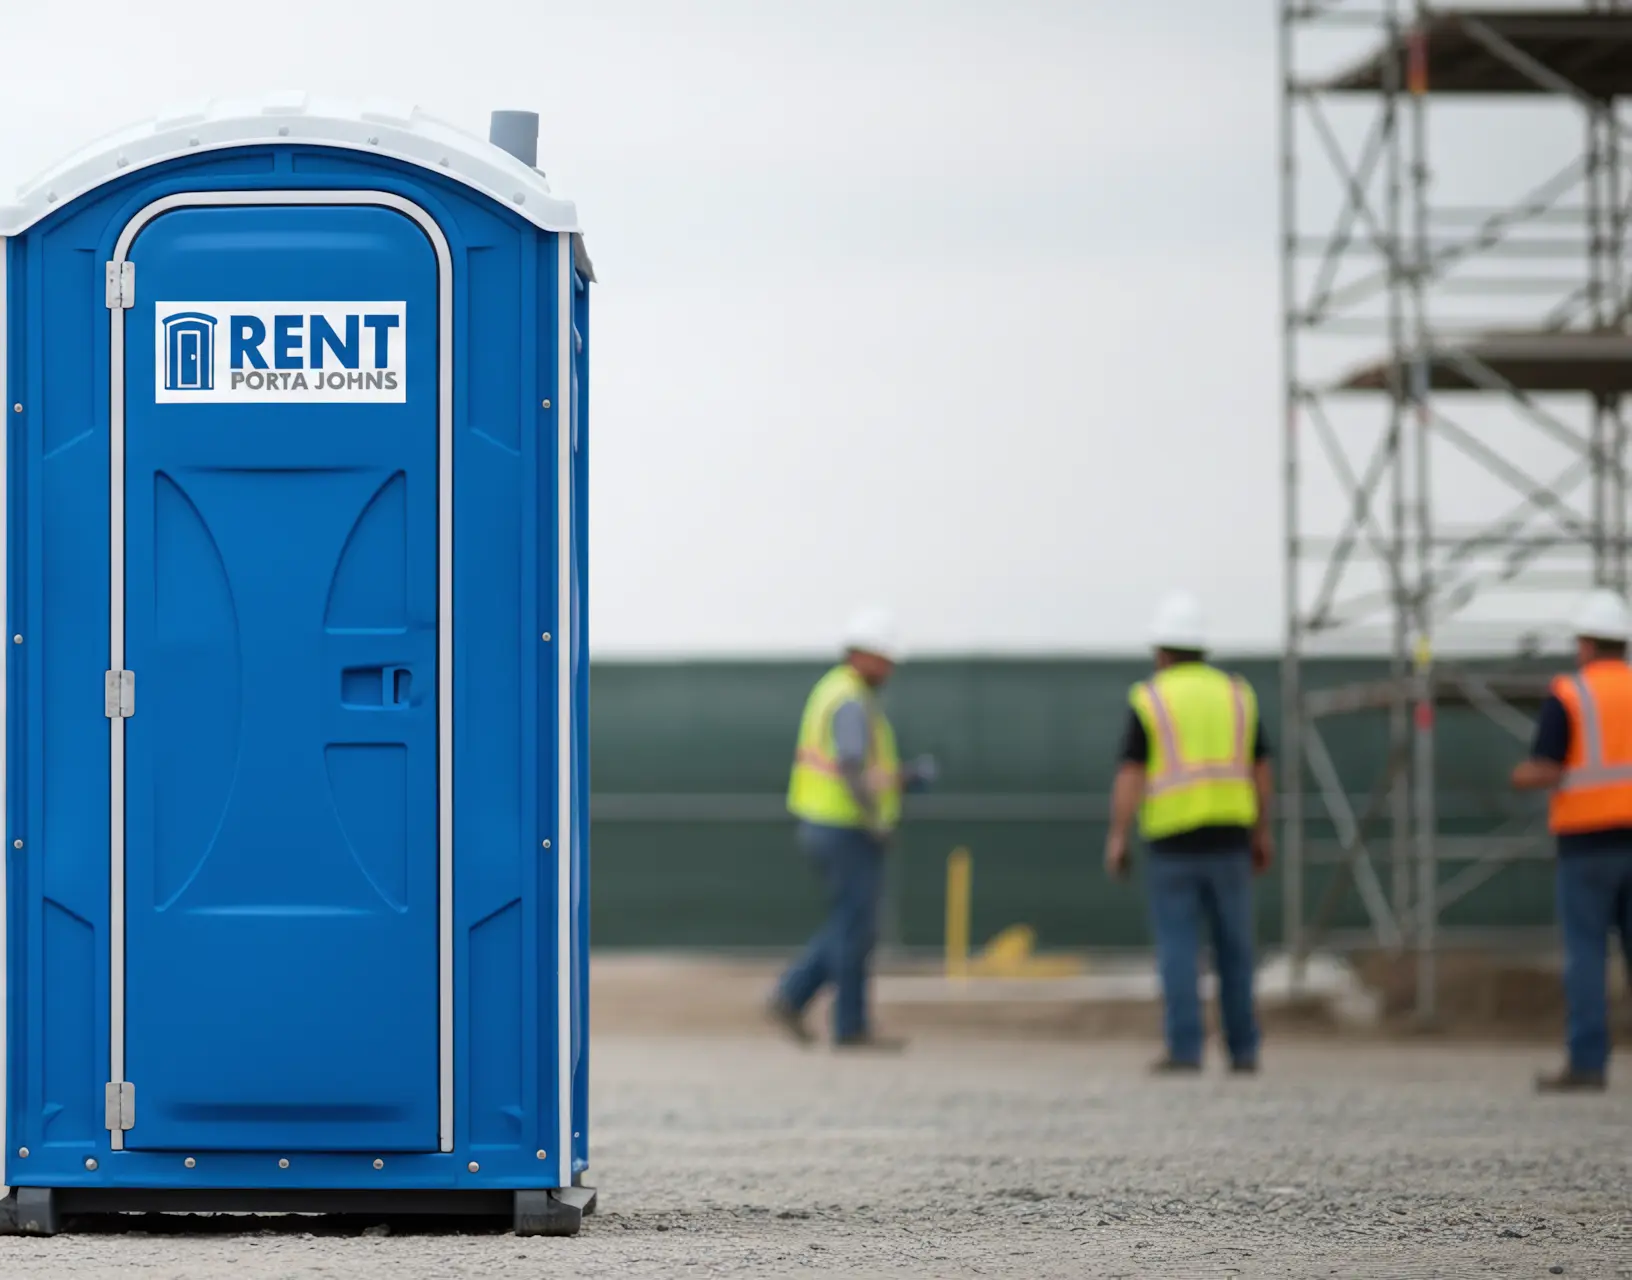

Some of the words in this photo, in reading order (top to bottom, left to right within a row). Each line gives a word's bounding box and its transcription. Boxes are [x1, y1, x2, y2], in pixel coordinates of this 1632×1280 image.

[230, 315, 400, 369] RENT
[231, 371, 308, 390] PORTA
[314, 371, 398, 390] JOHNS
